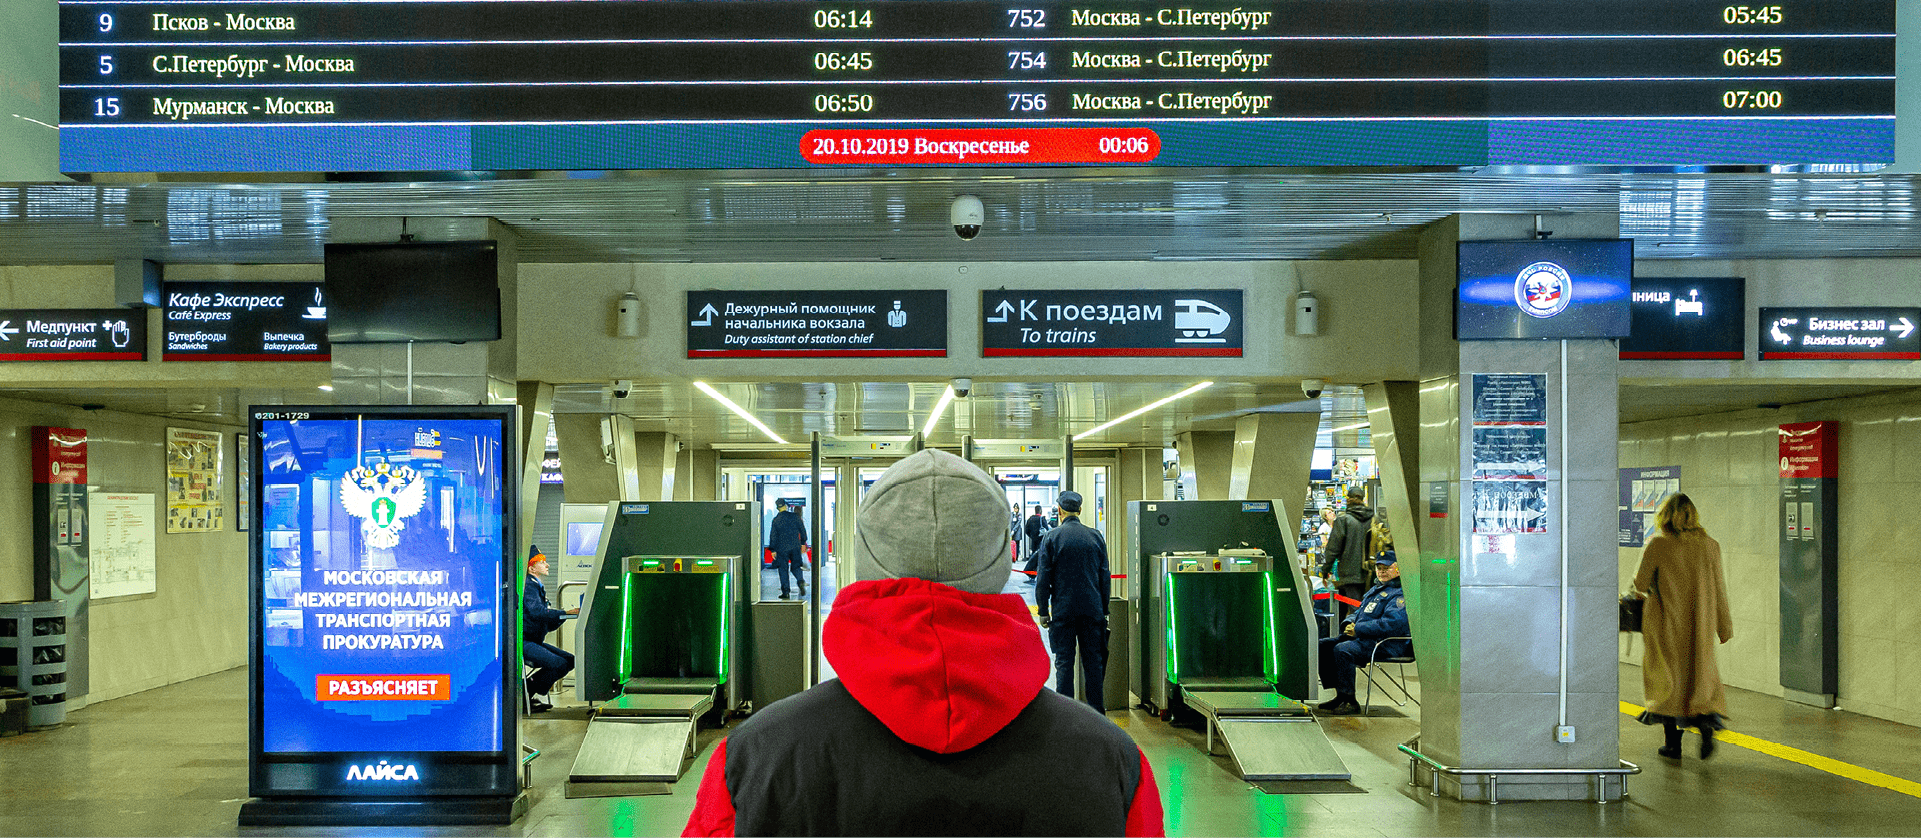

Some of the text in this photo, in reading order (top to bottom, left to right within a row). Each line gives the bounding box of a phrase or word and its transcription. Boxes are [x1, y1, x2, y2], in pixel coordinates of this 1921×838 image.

[99, 13, 113, 32] 9
[152, 13, 209, 31] Псков
[225, 13, 296, 31] Москва
[813, 9, 873, 29] 06:14
[1007, 8, 1046, 28] 752
[1071, 8, 1141, 27] Москва
[1157, 6, 1272, 31] С.Петербург
[1723, 6, 1783, 25] 05:45
[100, 55, 113, 74] 5
[152, 54, 269, 78] С.Петербург
[284, 54, 355, 72] Москва
[813, 51, 873, 71] 06:45
[1007, 50, 1047, 70] 754
[1071, 50, 1142, 69] Москва
[1157, 48, 1273, 73] С.Петербург
[1723, 48, 1783, 67] 06:45
[94, 97, 120, 117] 15
[152, 97, 249, 121] Мурманск
[264, 96, 335, 115] Москва
[813, 93, 873, 113] 06:50
[1007, 92, 1047, 112] 756
[1071, 92, 1142, 111] Москва
[1158, 90, 1273, 115] С.Петербург
[1722, 90, 1783, 109] 07:00
[812, 135, 1149, 159] 20.10.2019 Воскресенье 00:06
[168, 293, 285, 311] Кафе Экспресс
[724, 301, 876, 315] Дежурный помощник
[168, 310, 232, 322] Café Express
[1020, 299, 1163, 325] К поездам
[26, 320, 97, 336] Медпункт
[725, 318, 865, 330] начальника вокзала
[1808, 317, 1885, 331] Бизнес зал
[168, 331, 227, 342] Бутерброды
[263, 331, 305, 341] Выпечка
[724, 333, 875, 347] Duty assistant of station chief
[1019, 326, 1097, 343] To trains
[1803, 333, 1885, 348] Business lounge
[26, 338, 97, 350] First aid point
[168, 342, 208, 351] Sandwiches
[263, 342, 318, 352] Bakery products
[324, 570, 444, 586] МОСКОВСКАЯ
[294, 590, 472, 608] МЕЖРЕГИОНАЛЬНАЯ
[316, 612, 451, 629] ТРАНСПОРТНАЯ
[323, 633, 444, 650] ПРОКУРАТУРА
[328, 680, 439, 695] РАЗЪЯСНЯЕТ
[346, 760, 419, 781] ЛАЙСА
